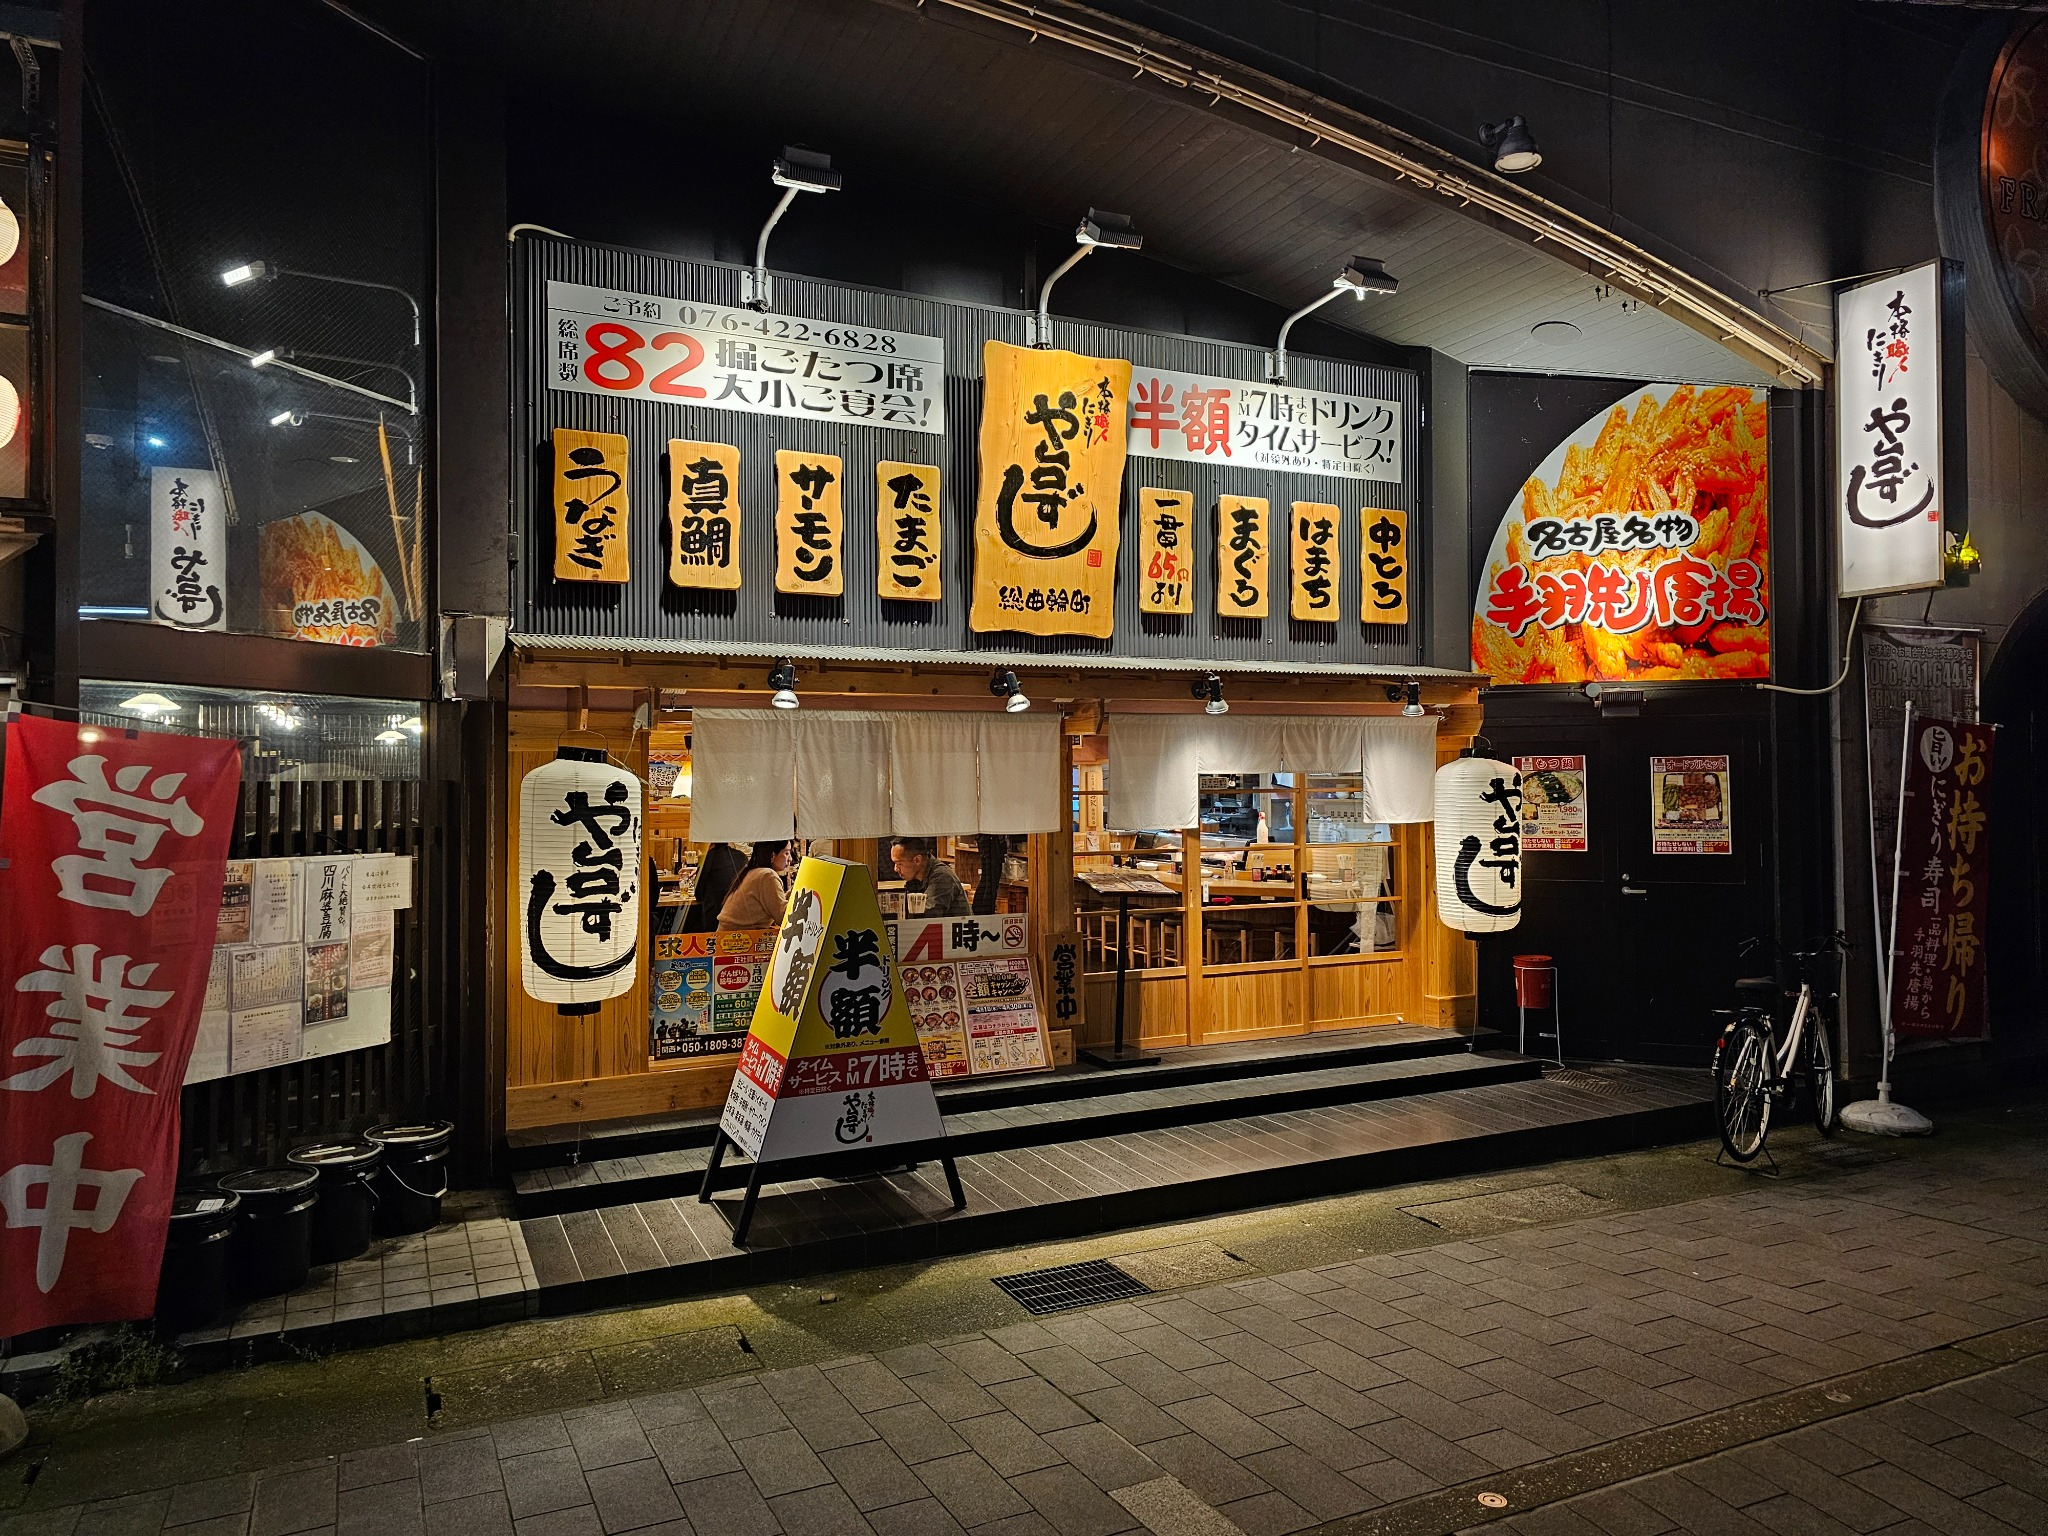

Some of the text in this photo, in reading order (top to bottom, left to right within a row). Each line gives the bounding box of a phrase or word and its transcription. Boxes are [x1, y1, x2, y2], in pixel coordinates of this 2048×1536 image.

[1999, 176, 2048, 221] FR
[557, 318, 579, 384] 総席数
[583, 322, 707, 398] 82
[603, 296, 897, 354] ご予約 076-422-6828
[1867, 328, 1887, 391] にぎり
[1886, 290, 1912, 384] 本格職人
[713, 372, 931, 427] 大小ご宴会!
[714, 338, 924, 392] 掘ごたつ席
[1081, 397, 1094, 449] にぎり
[1094, 376, 1114, 445] 本格職人
[1131, 378, 1232, 457] 半額
[1236, 420, 1395, 464] タイムサービス!
[563, 447, 622, 570] うなぎ
[681, 456, 731, 568] 真鯛
[789, 463, 835, 582] サーモン
[886, 472, 938, 587] たまご
[1527, 514, 1694, 557] 名古屋名物
[1229, 505, 1261, 607] まぐろ
[1299, 516, 1334, 610] はまち
[1369, 515, 1403, 609] 中とろ
[999, 585, 1090, 614] 総曲輪町
[1486, 555, 1764, 634] 手羽先唐揚
[1666, 758, 1726, 770] オードブルセット
[1921, 775, 1948, 915] にぎり寿司
[1942, 732, 1988, 1031] お持ち帰り
[319, 865, 337, 940] 四川麻婆豆腐
[778, 887, 815, 1022] 半額
[829, 928, 882, 1039] 半額
[881, 955, 892, 1000] ドリンク
[966, 982, 990, 997] 全額
[1053, 944, 1077, 1020] 営業中
[1903, 927, 1926, 1011] 手羽先唐揚
[0, 755, 205, 1294] 営業中
[788, 1071, 841, 1089] サービス
[797, 1058, 833, 1073] タイム
